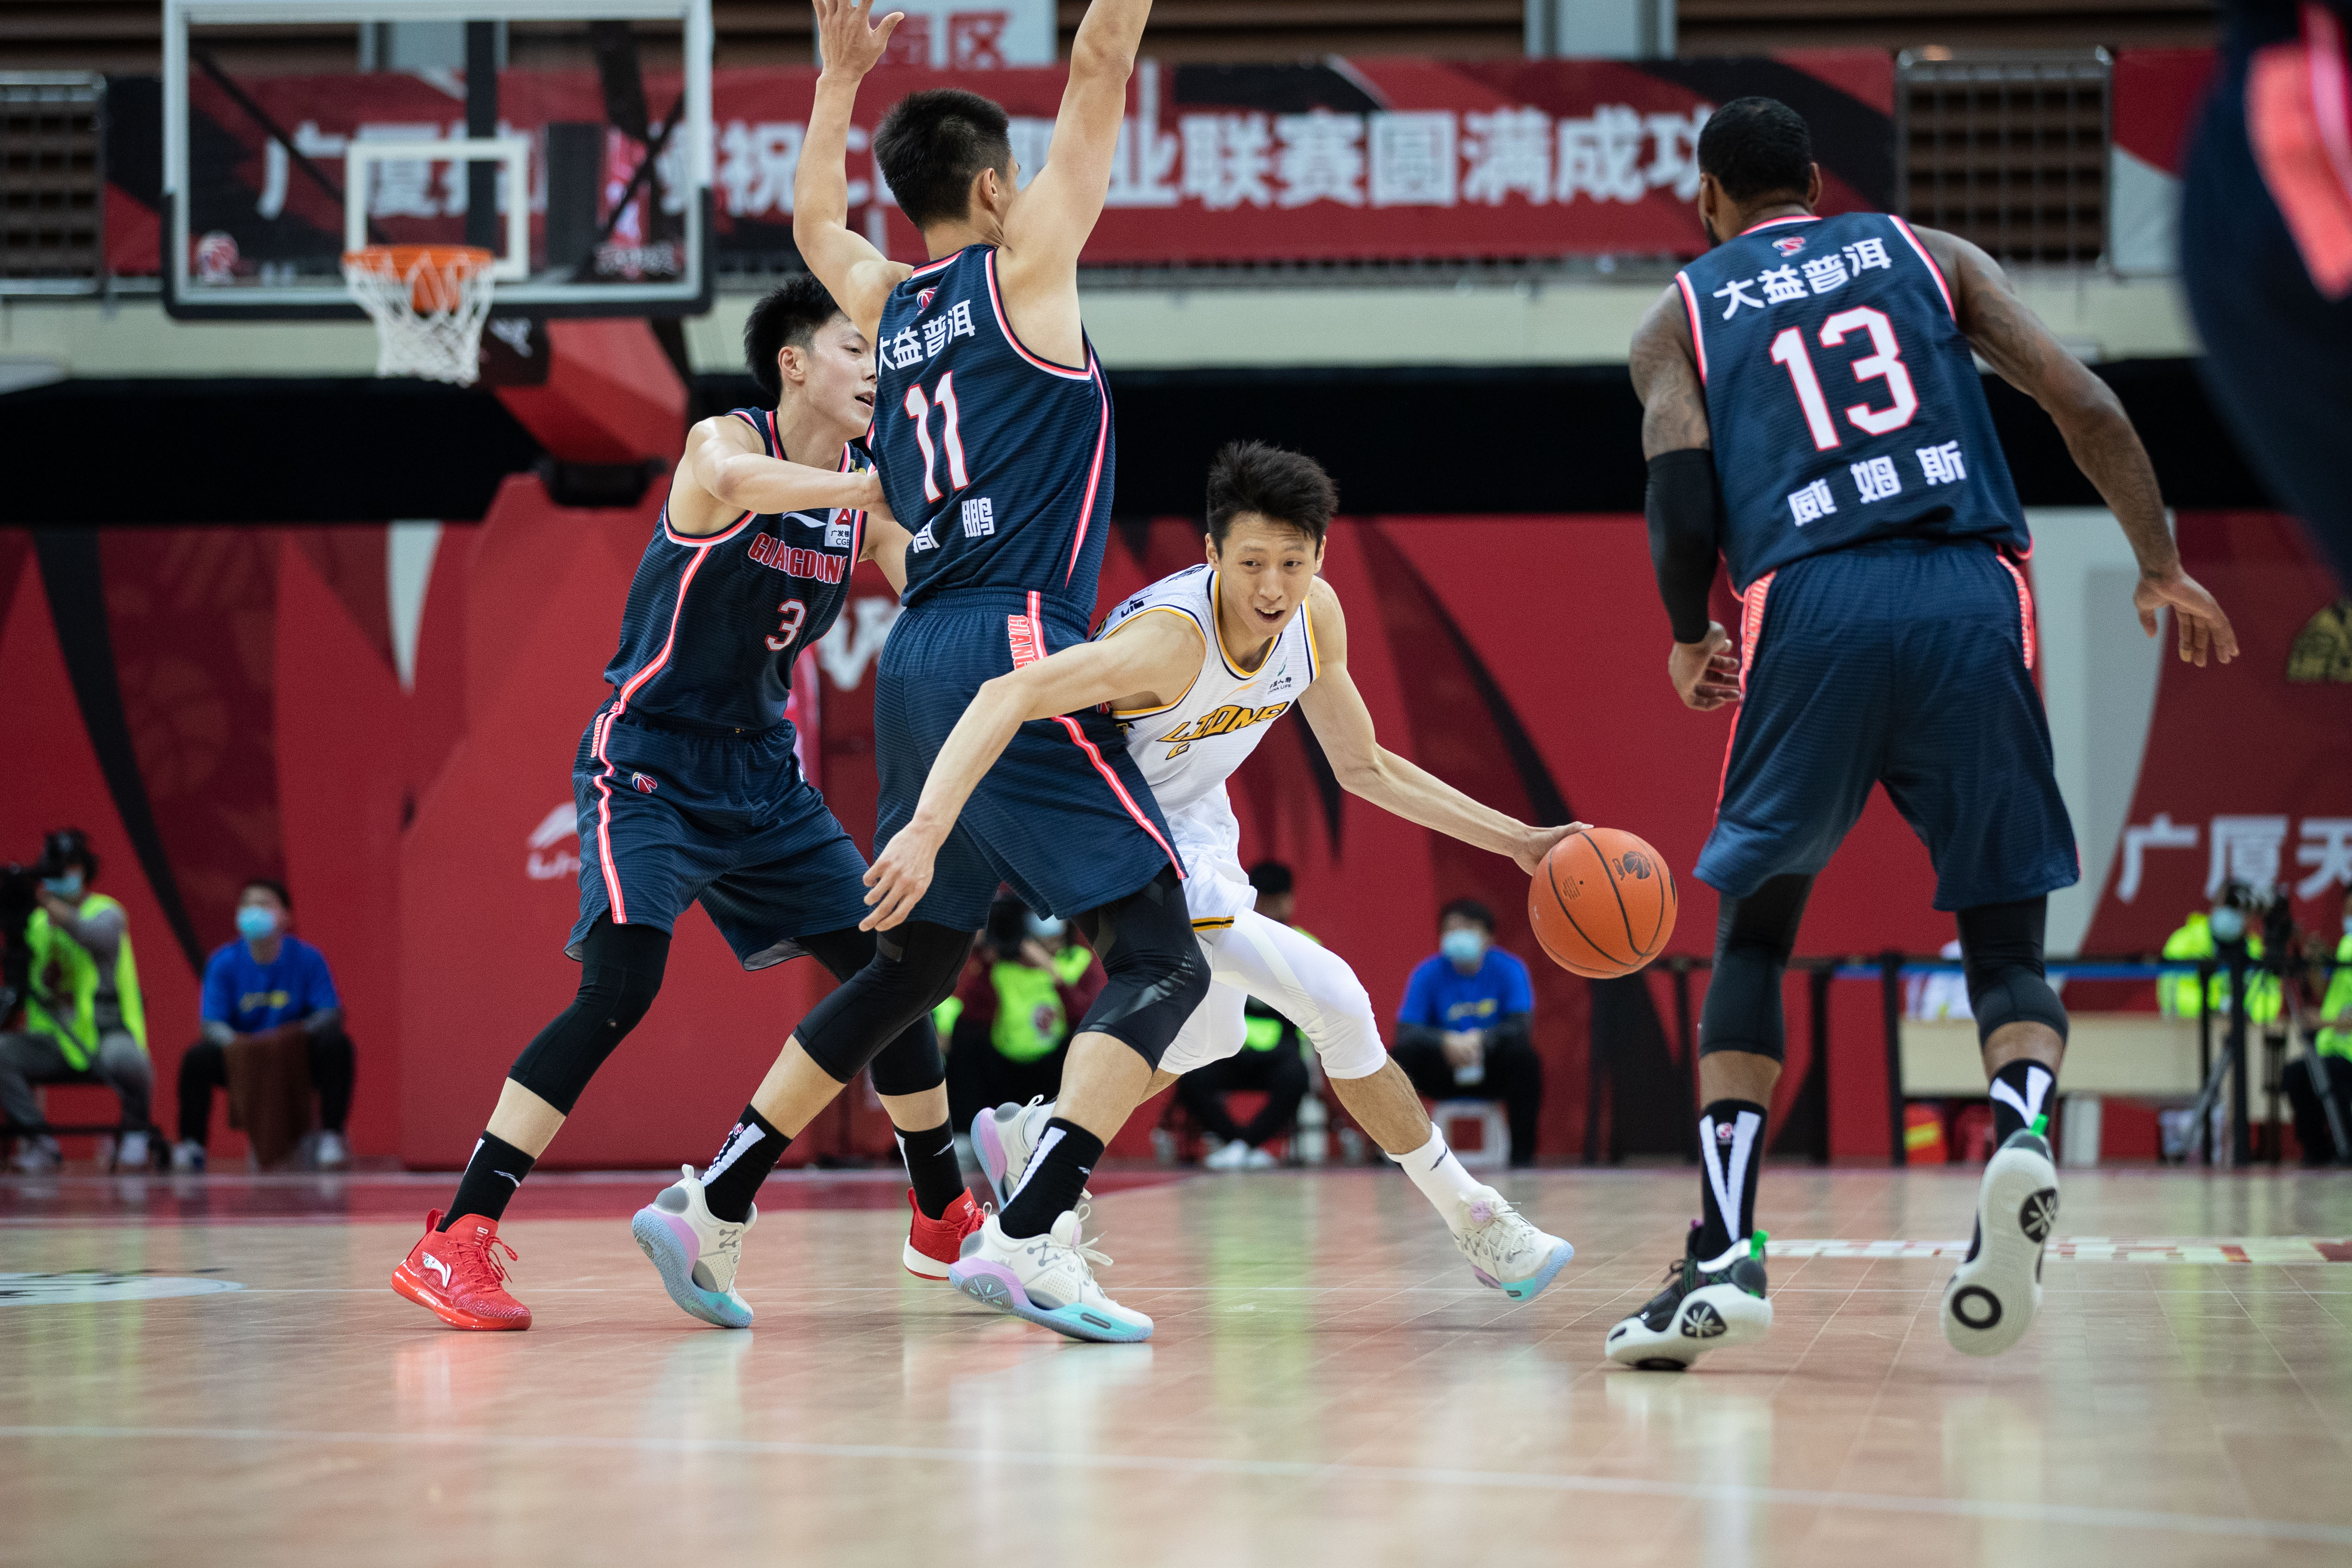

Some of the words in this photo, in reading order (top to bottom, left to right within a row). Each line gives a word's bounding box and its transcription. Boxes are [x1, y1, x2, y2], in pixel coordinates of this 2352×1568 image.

[1713, 237, 1892, 320] 大益普洱
[878, 299, 976, 377] 大益普洱
[1769, 305, 1920, 451] 13
[904, 370, 970, 504] 11
[1787, 441, 1967, 527] 威姆斯
[765, 598, 807, 651] 3
